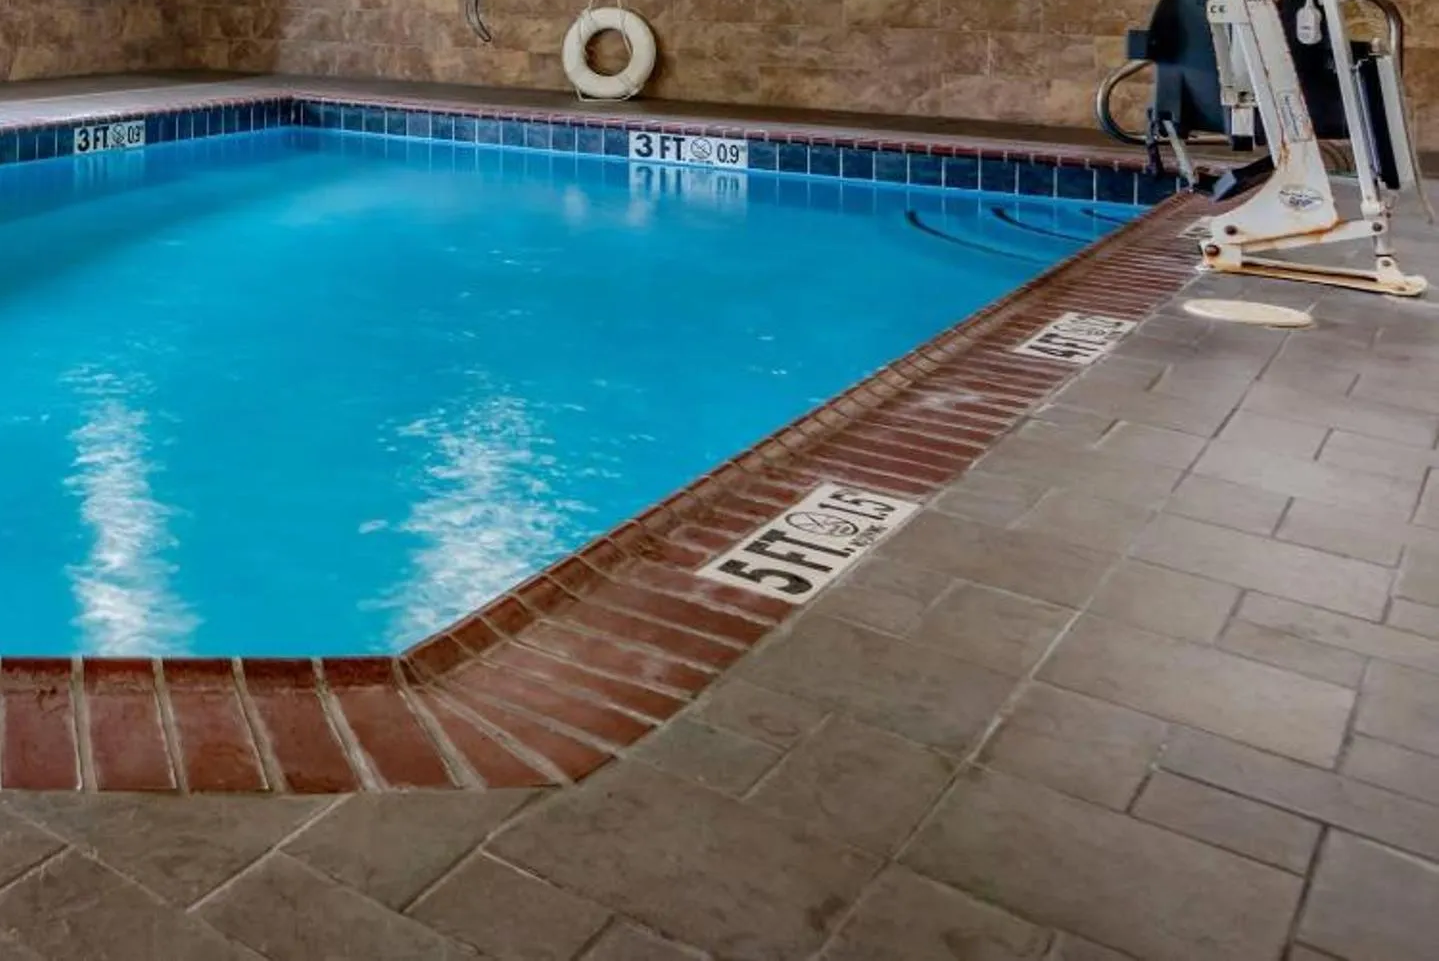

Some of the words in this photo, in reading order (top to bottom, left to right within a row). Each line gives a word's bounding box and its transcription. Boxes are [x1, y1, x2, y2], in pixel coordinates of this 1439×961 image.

[78, 127, 90, 152] 3
[635, 133, 653, 157] 3
[717, 143, 739, 164] 0.9
[718, 559, 813, 595] 5
